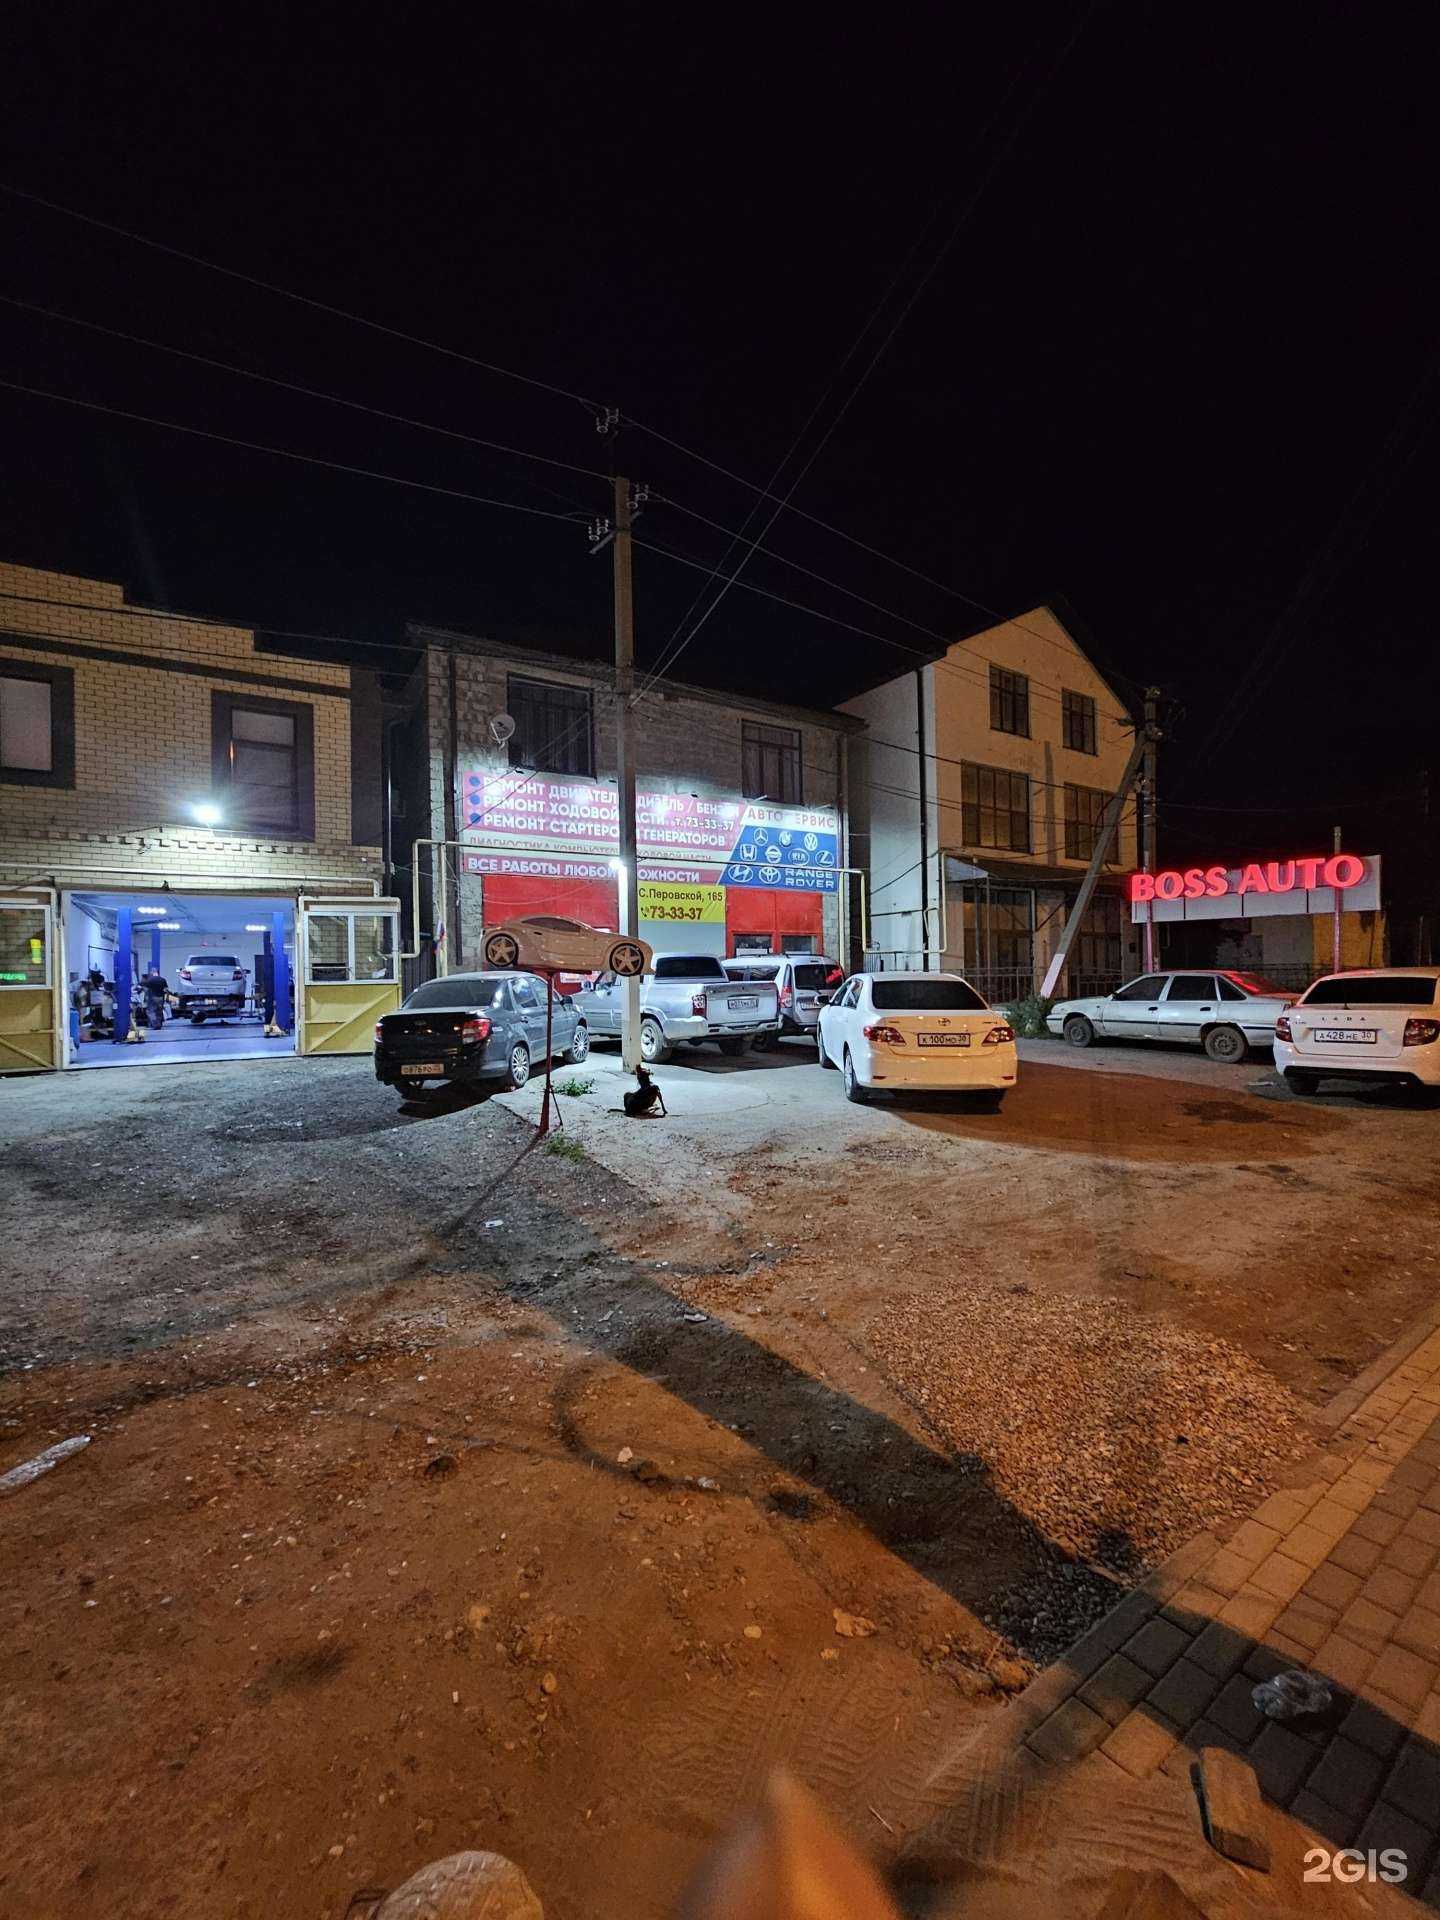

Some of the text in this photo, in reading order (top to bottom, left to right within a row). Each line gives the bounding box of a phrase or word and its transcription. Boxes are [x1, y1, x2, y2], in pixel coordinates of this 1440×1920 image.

[483, 776, 546, 795] РЕМОНТ
[483, 795, 546, 813] РЕМОНТ
[549, 802, 620, 821] ХОДОВОЙ
[483, 813, 546, 831] РЕМОНТ
[549, 821, 620, 838] СТАРТЕРО
[643, 829, 726, 846] ГЕНЕРАТОРОВ
[467, 857, 498, 871] ВСЕ
[501, 859, 561, 877] РАБОТЫ
[637, 868, 700, 882] ОЖНОСТИ
[784, 866, 834, 879] RANGE
[1131, 854, 1364, 902] BOSS AUTO
[784, 877, 835, 889] ROVER
[707, 891, 724, 902] 165
[649, 905, 704, 921] 73-33-37
